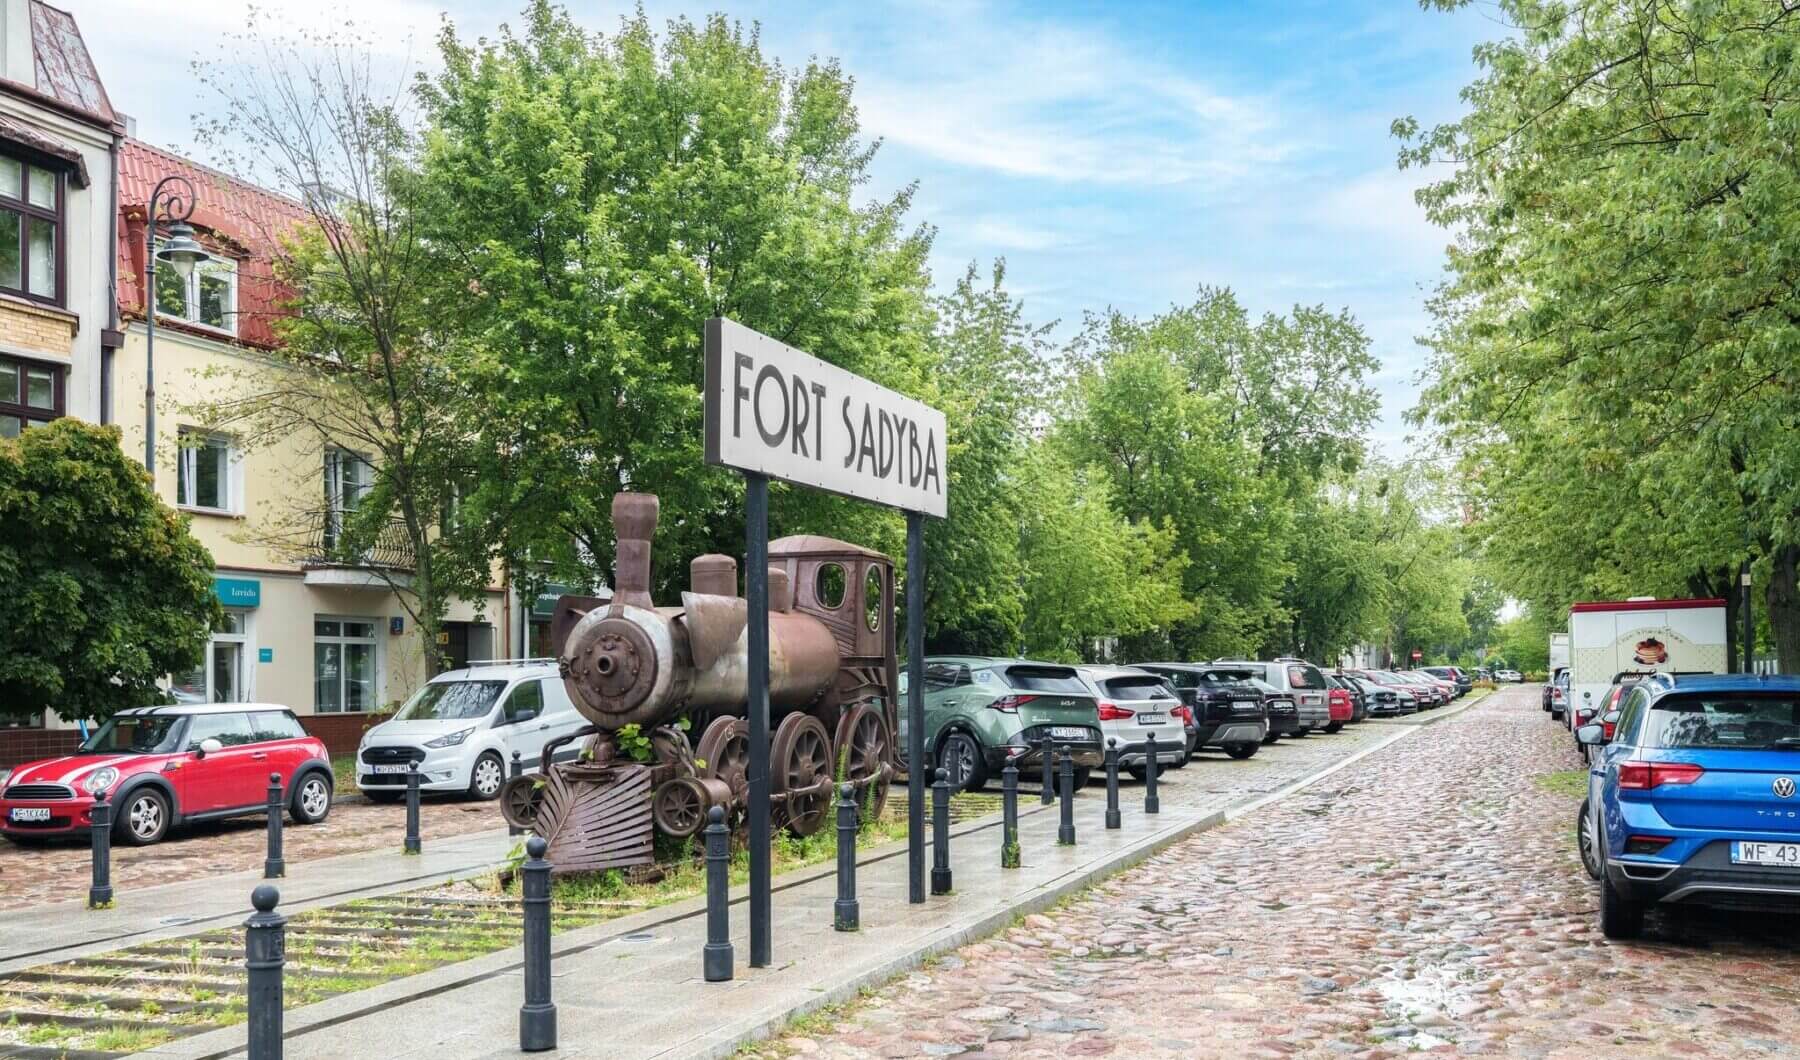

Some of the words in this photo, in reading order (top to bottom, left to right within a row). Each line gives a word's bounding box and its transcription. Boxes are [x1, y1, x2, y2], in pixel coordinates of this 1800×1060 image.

[733, 351, 826, 461] FORT
[842, 395, 941, 495] SADYBA
[1756, 810, 1796, 818] T-RO
[1743, 843, 1768, 861] WF
[1775, 845, 1798, 862] 43
